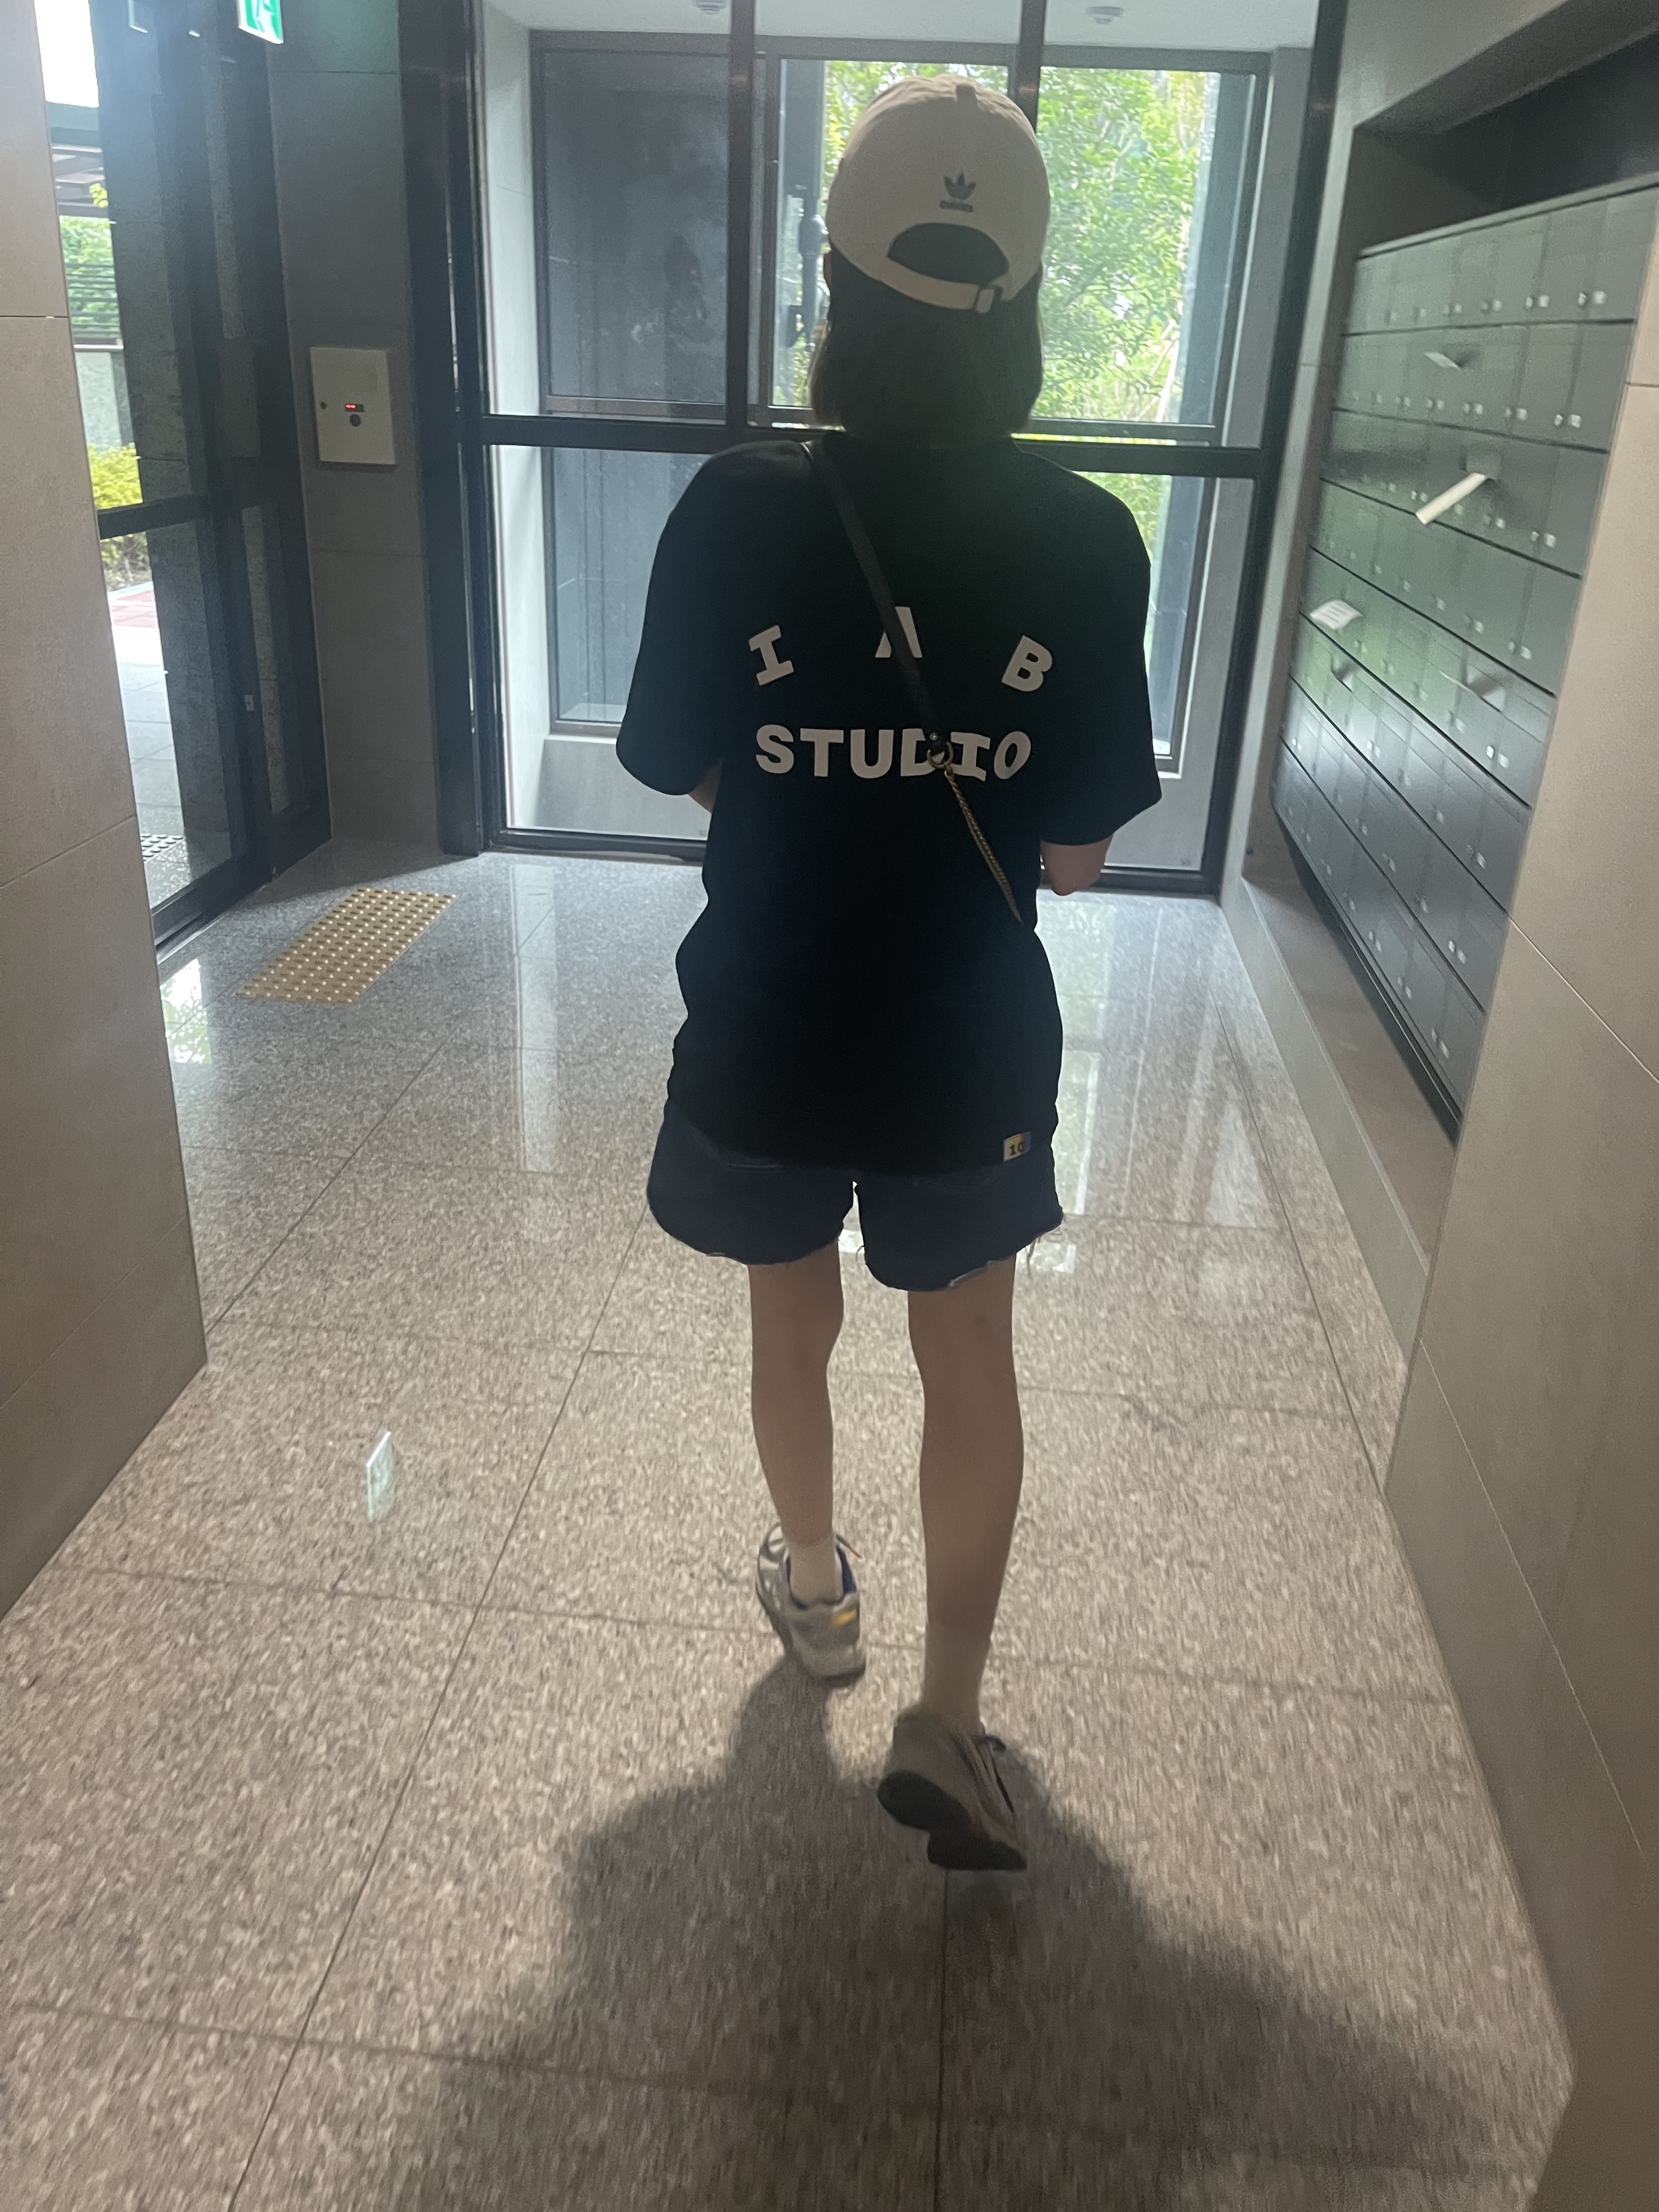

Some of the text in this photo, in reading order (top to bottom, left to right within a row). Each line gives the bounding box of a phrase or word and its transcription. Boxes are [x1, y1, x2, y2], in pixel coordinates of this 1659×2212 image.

[748, 625, 794, 686] I
[1001, 635, 1053, 692] B
[755, 724, 1031, 782] STUDIO
